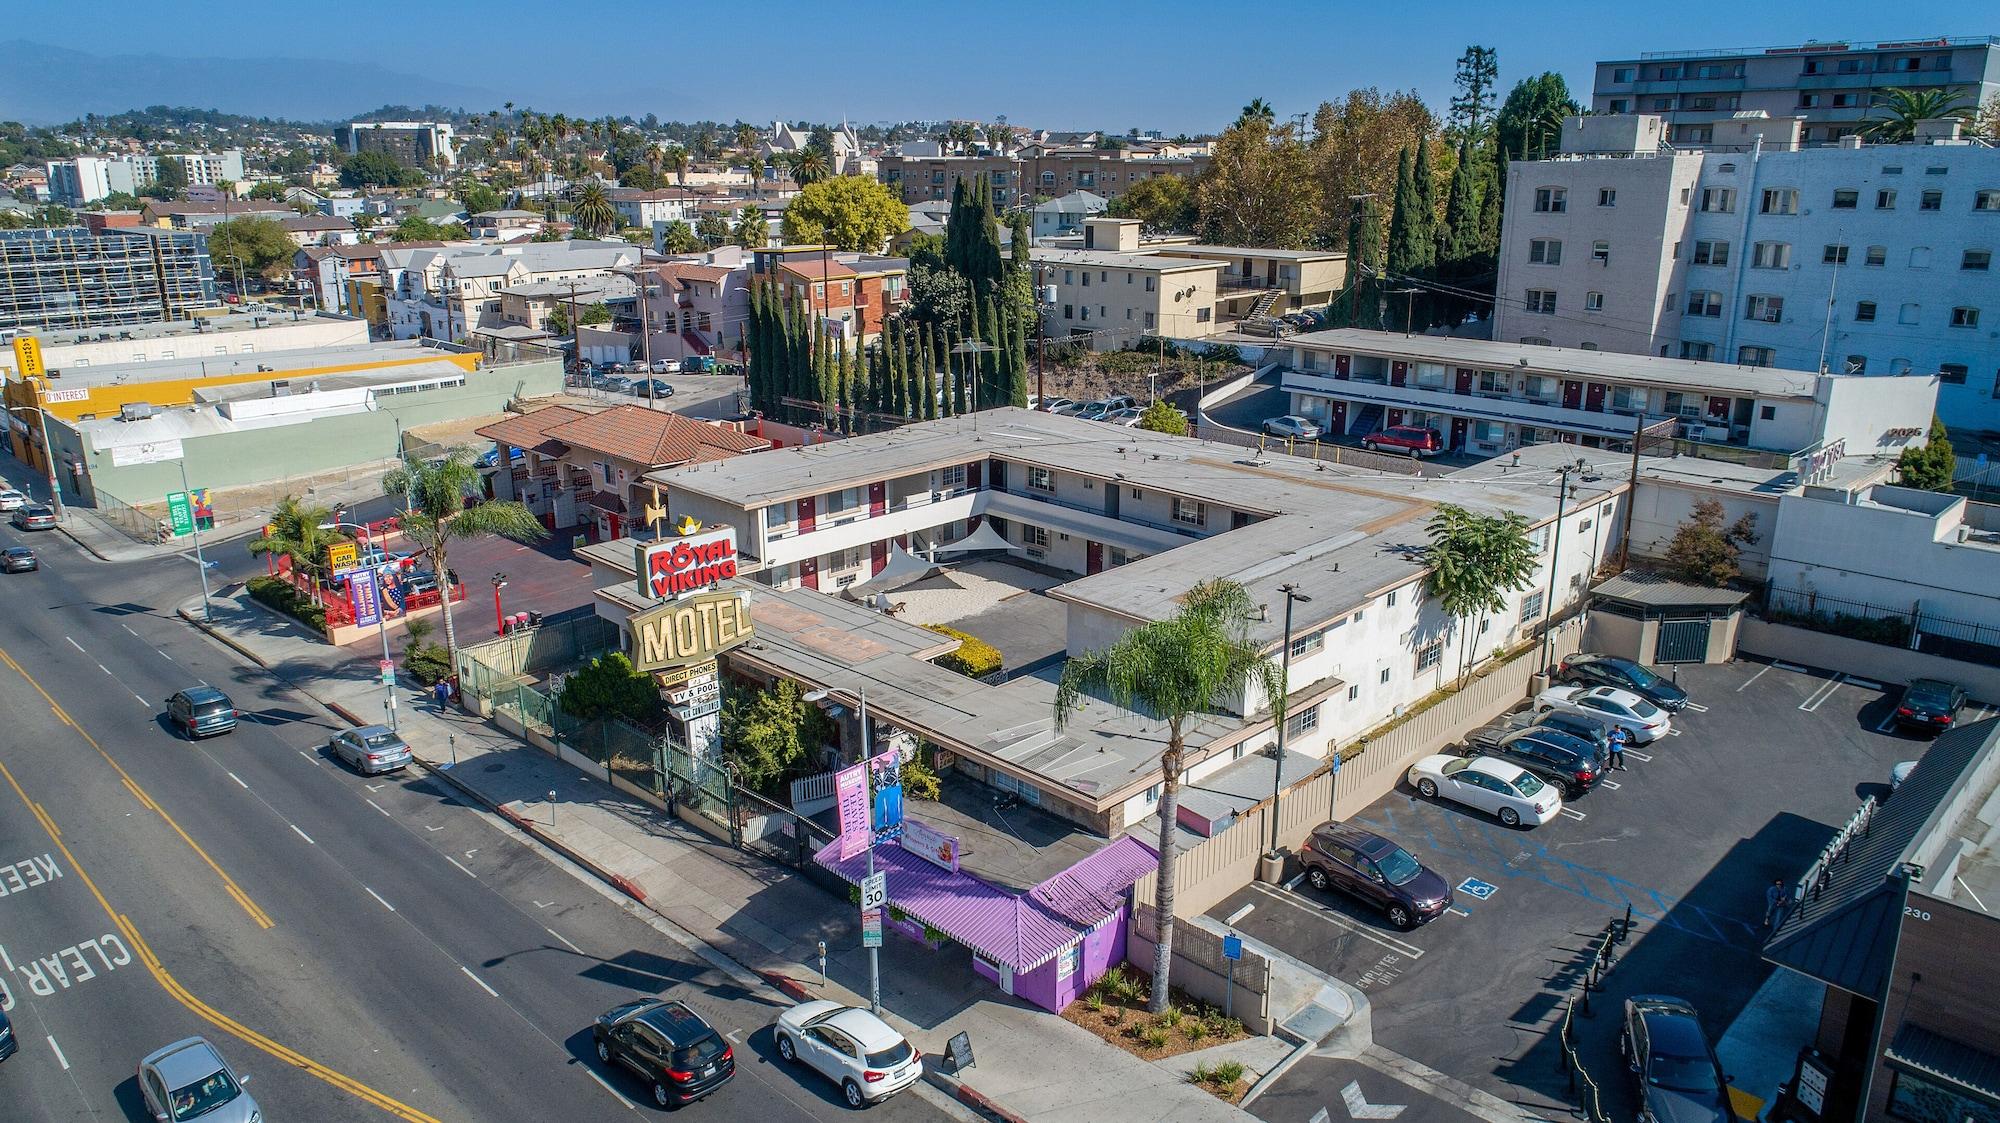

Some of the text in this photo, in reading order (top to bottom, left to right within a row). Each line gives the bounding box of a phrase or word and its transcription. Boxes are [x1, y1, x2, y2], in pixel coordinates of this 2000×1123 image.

[334, 560, 356, 569] WASH
[336, 554, 352, 563] CAR
[650, 538, 736, 576] ROYAL
[651, 559, 736, 597] VIKING
[356, 584, 367, 616] COUNTRY
[363, 582, 376, 616] INDIAN
[642, 598, 753, 664] MOTEL
[665, 662, 716, 684] DIRECT PHONES
[674, 692, 685, 701] TV
[697, 683, 718, 695] POOL
[683, 711, 691, 719] AIR
[840, 768, 862, 783] AUTRY
[840, 775, 863, 789] MUSEUM
[843, 796, 851, 818] THE
[849, 792, 859, 832] LEAVES
[857, 790, 866, 833] COYOTE
[864, 875, 883, 888] SPEED
[865, 882, 882, 894] LIMIT
[866, 890, 883, 906] 30
[1903, 906, 1931, 921] 230
[18, 933, 132, 996] CLEAR
[1355, 953, 1400, 989] EMPLOYEE
[1377, 965, 1403, 986] ONLY
